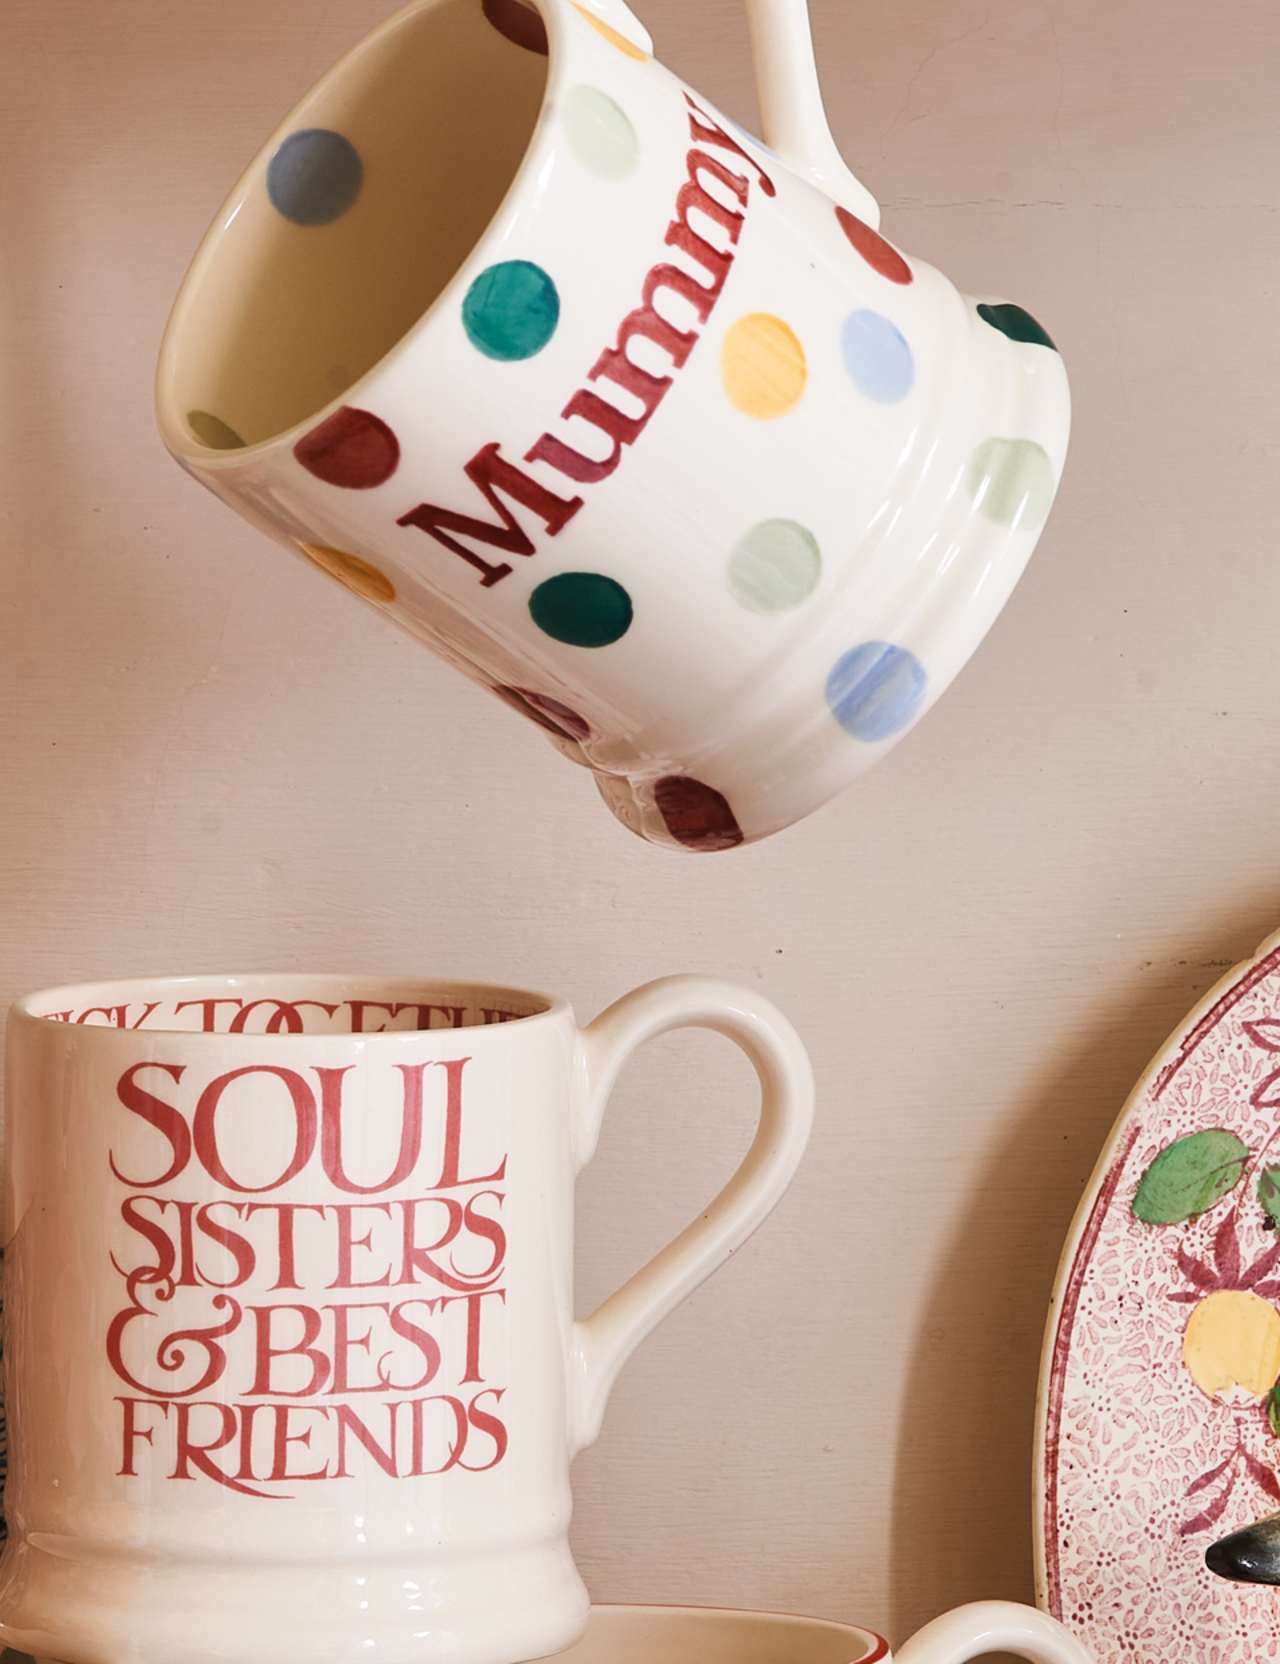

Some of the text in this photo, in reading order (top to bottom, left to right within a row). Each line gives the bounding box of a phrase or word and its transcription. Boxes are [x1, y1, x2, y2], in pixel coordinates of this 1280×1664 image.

[396, 90, 776, 588] Mummy
[109, 1056, 508, 1194] SOUL
[109, 1190, 507, 1292] SISTERS
[106, 1266, 507, 1398] & BEST
[113, 1387, 509, 1500] FRIENDS
